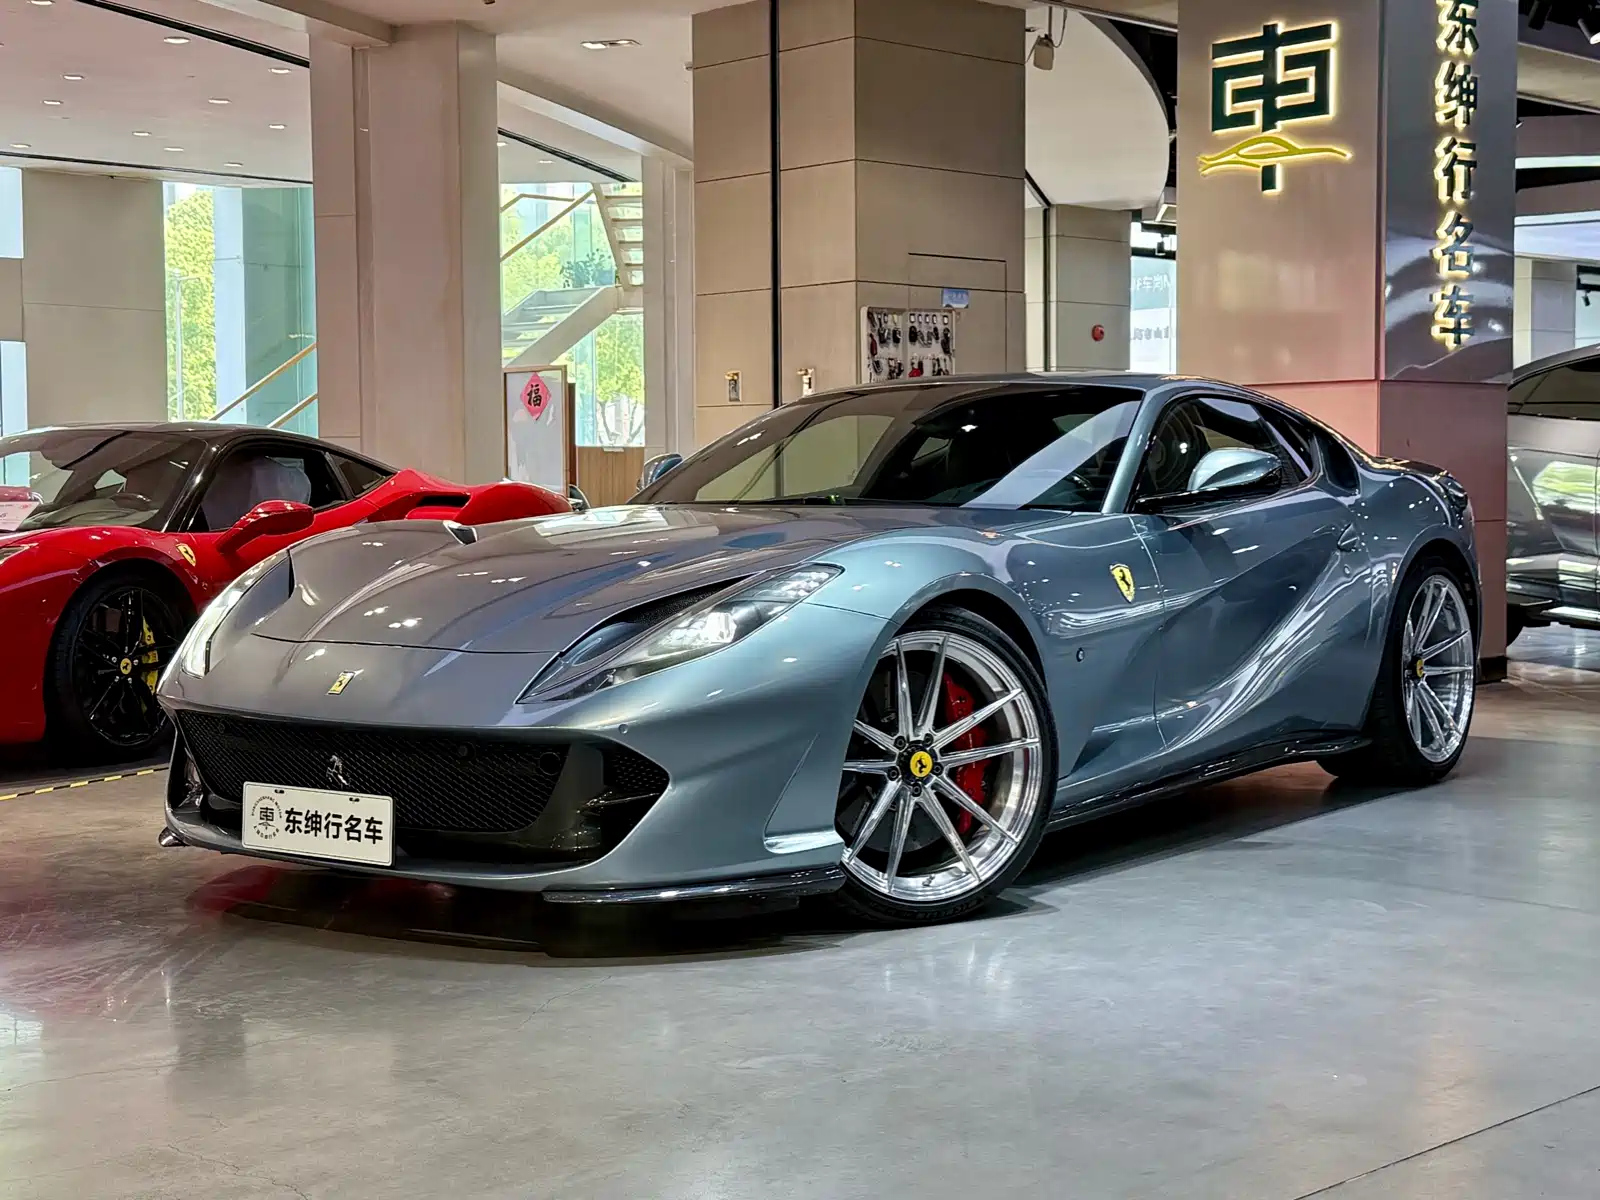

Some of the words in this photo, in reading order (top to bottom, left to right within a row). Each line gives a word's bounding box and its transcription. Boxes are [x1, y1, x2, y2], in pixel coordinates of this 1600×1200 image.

[1432, 0, 1478, 350] 东绅行名车
[527, 383, 542, 407] 福
[285, 807, 384, 845] 东绅行名车
